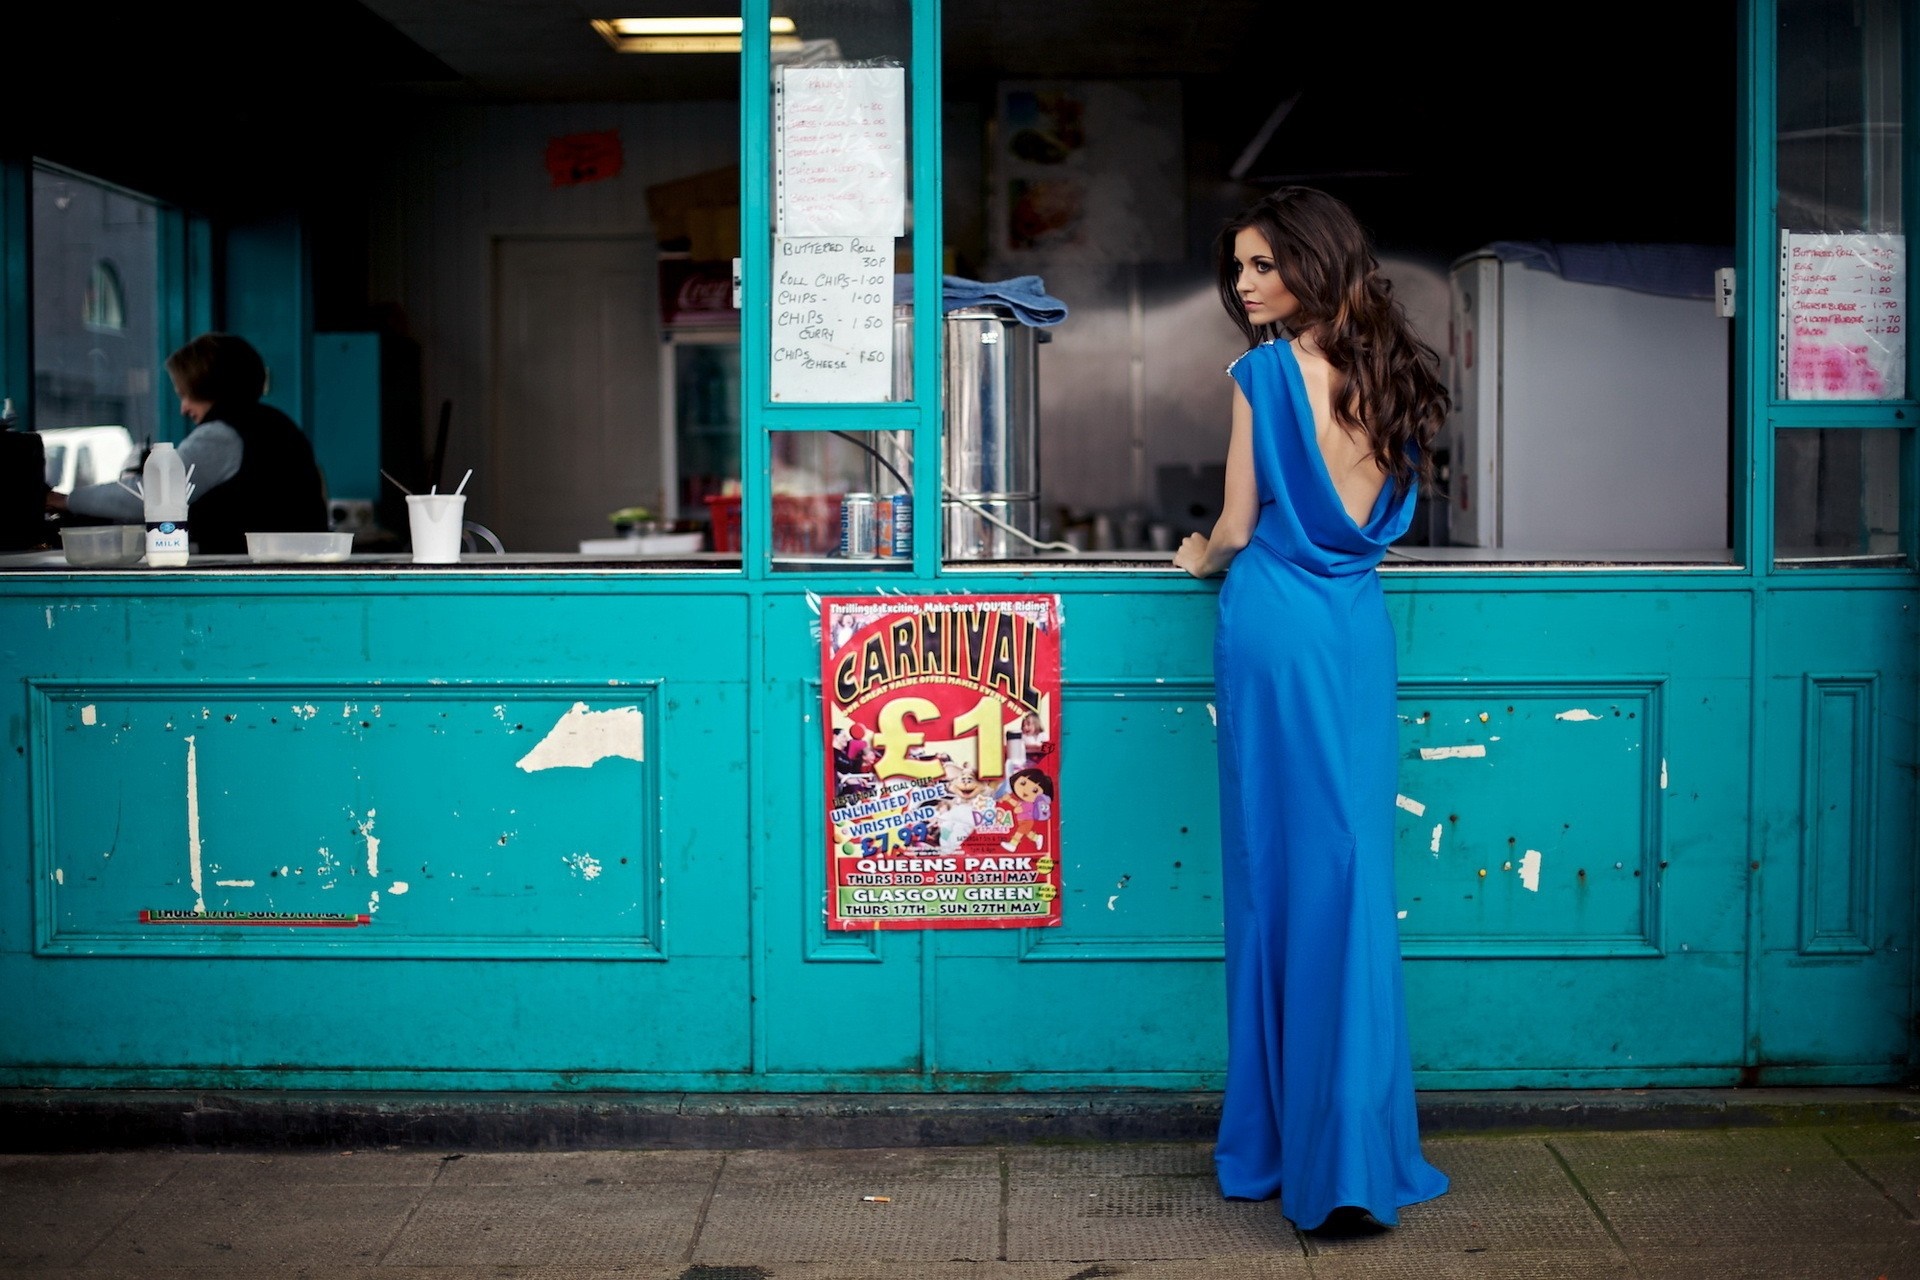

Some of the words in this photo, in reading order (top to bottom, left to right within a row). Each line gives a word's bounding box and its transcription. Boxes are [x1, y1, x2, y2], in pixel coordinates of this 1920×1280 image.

[783, 242, 844, 256] BUTTERED
[850, 237, 875, 253] ROLL
[780, 270, 808, 286] ROLL
[778, 290, 817, 305] CHIPS
[778, 309, 824, 326] CHIPS
[773, 347, 810, 362] CHIPS
[830, 603, 871, 615] Thrilling
[924, 602, 950, 613] Make
[952, 602, 975, 613] Sure
[976, 602, 1013, 613] YOU'RE
[1015, 601, 1049, 612] Riding!
[836, 608, 1042, 714] CARNIVAL
[888, 677, 918, 690] VALUE
[918, 675, 946, 684] OFFER
[947, 676, 979, 691] MAKES
[880, 780, 909, 796] SPECIAL
[910, 775, 934, 788] OFFER
[831, 795, 908, 821] UNLIMITED
[912, 785, 945, 803] RIDE
[849, 807, 936, 836] WRISTBAND
[972, 809, 1013, 826] DORA
[861, 822, 928, 858] £7.99
[857, 858, 957, 873] QUEENS
[965, 857, 1032, 871] PARK
[848, 874, 892, 885] THURS
[895, 874, 923, 884] 3RD
[937, 873, 964, 883] SUN
[970, 872, 1002, 883] 13TH
[1007, 871, 1037, 883] MAY
[853, 888, 958, 902] GLASGOW
[964, 886, 1033, 901] GREEN
[846, 905, 889, 915] THURS
[894, 905, 926, 914] 17TH
[940, 904, 968, 914] SUN
[972, 903, 1006, 913] 27TH
[1010, 902, 1040, 913] MAY
